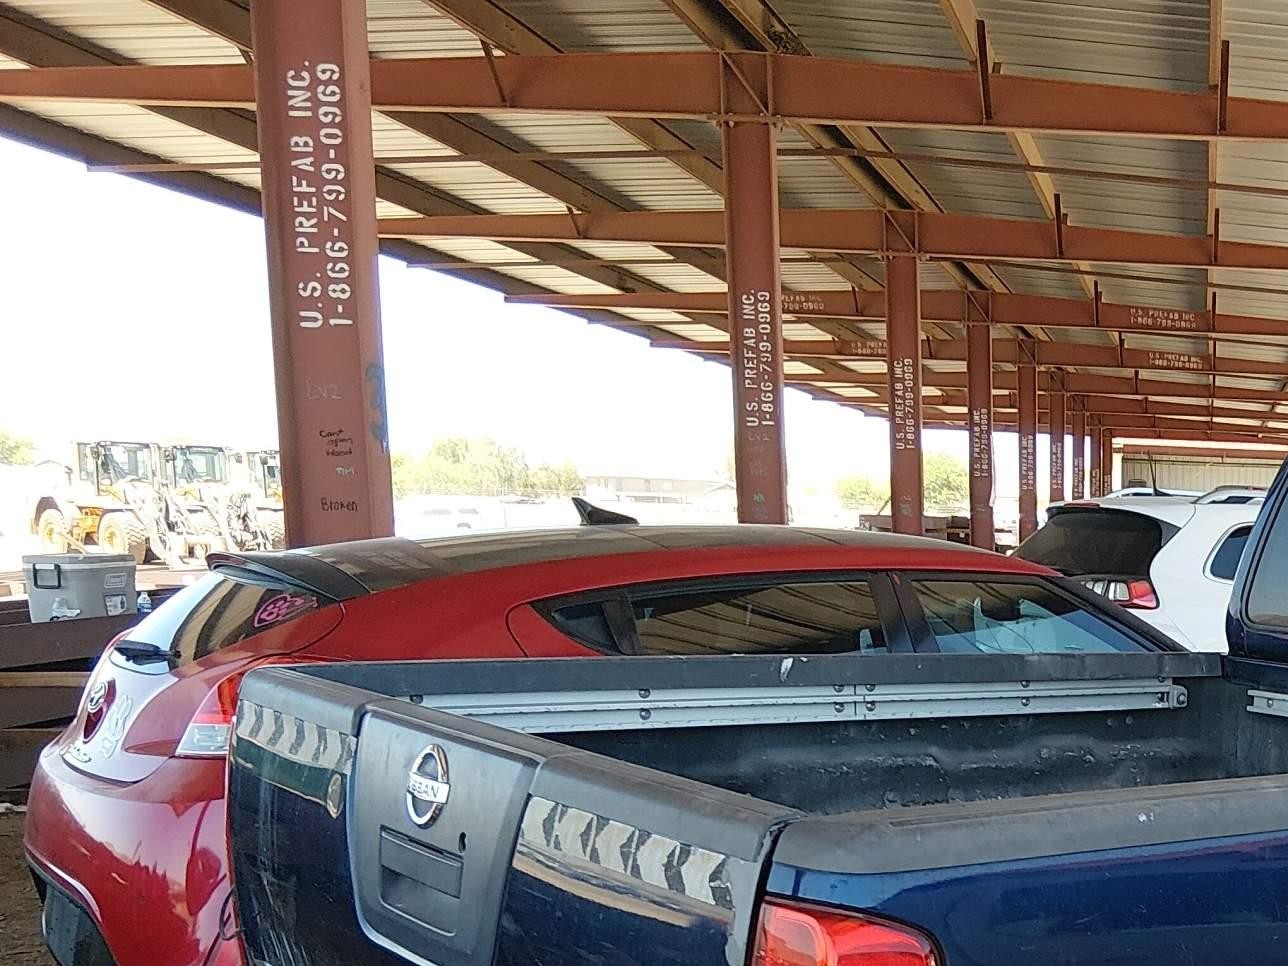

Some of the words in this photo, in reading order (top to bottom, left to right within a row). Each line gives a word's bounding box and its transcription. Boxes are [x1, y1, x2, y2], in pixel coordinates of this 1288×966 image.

[286, 60, 313, 117] INC.
[290, 136, 320, 253] PREFAB
[316, 63, 353, 327] 1-866-799-0969
[298, 272, 323, 328] U.S.
[742, 289, 756, 319] INC.
[743, 327, 758, 388] PREFAB
[757, 291, 775, 426] 1-866-799-0969
[746, 397, 759, 427] U.S.
[894, 383, 905, 424] PREFAB
